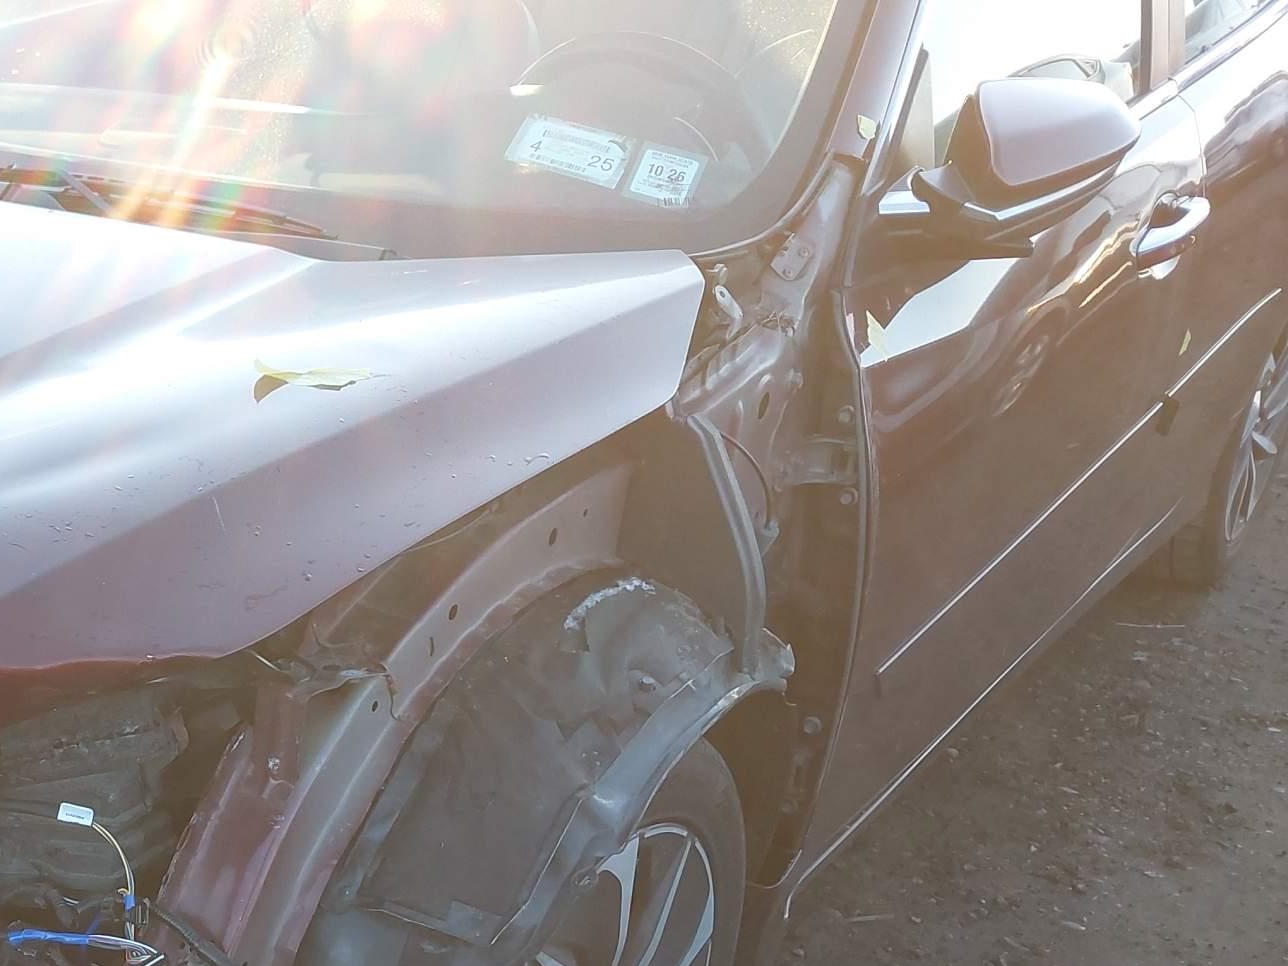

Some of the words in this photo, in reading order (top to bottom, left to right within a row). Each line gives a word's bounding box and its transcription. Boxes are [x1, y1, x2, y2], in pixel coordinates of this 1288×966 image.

[529, 140, 542, 153] 4
[587, 155, 615, 172] 25
[648, 163, 665, 177] 10
[667, 168, 687, 183] 26
